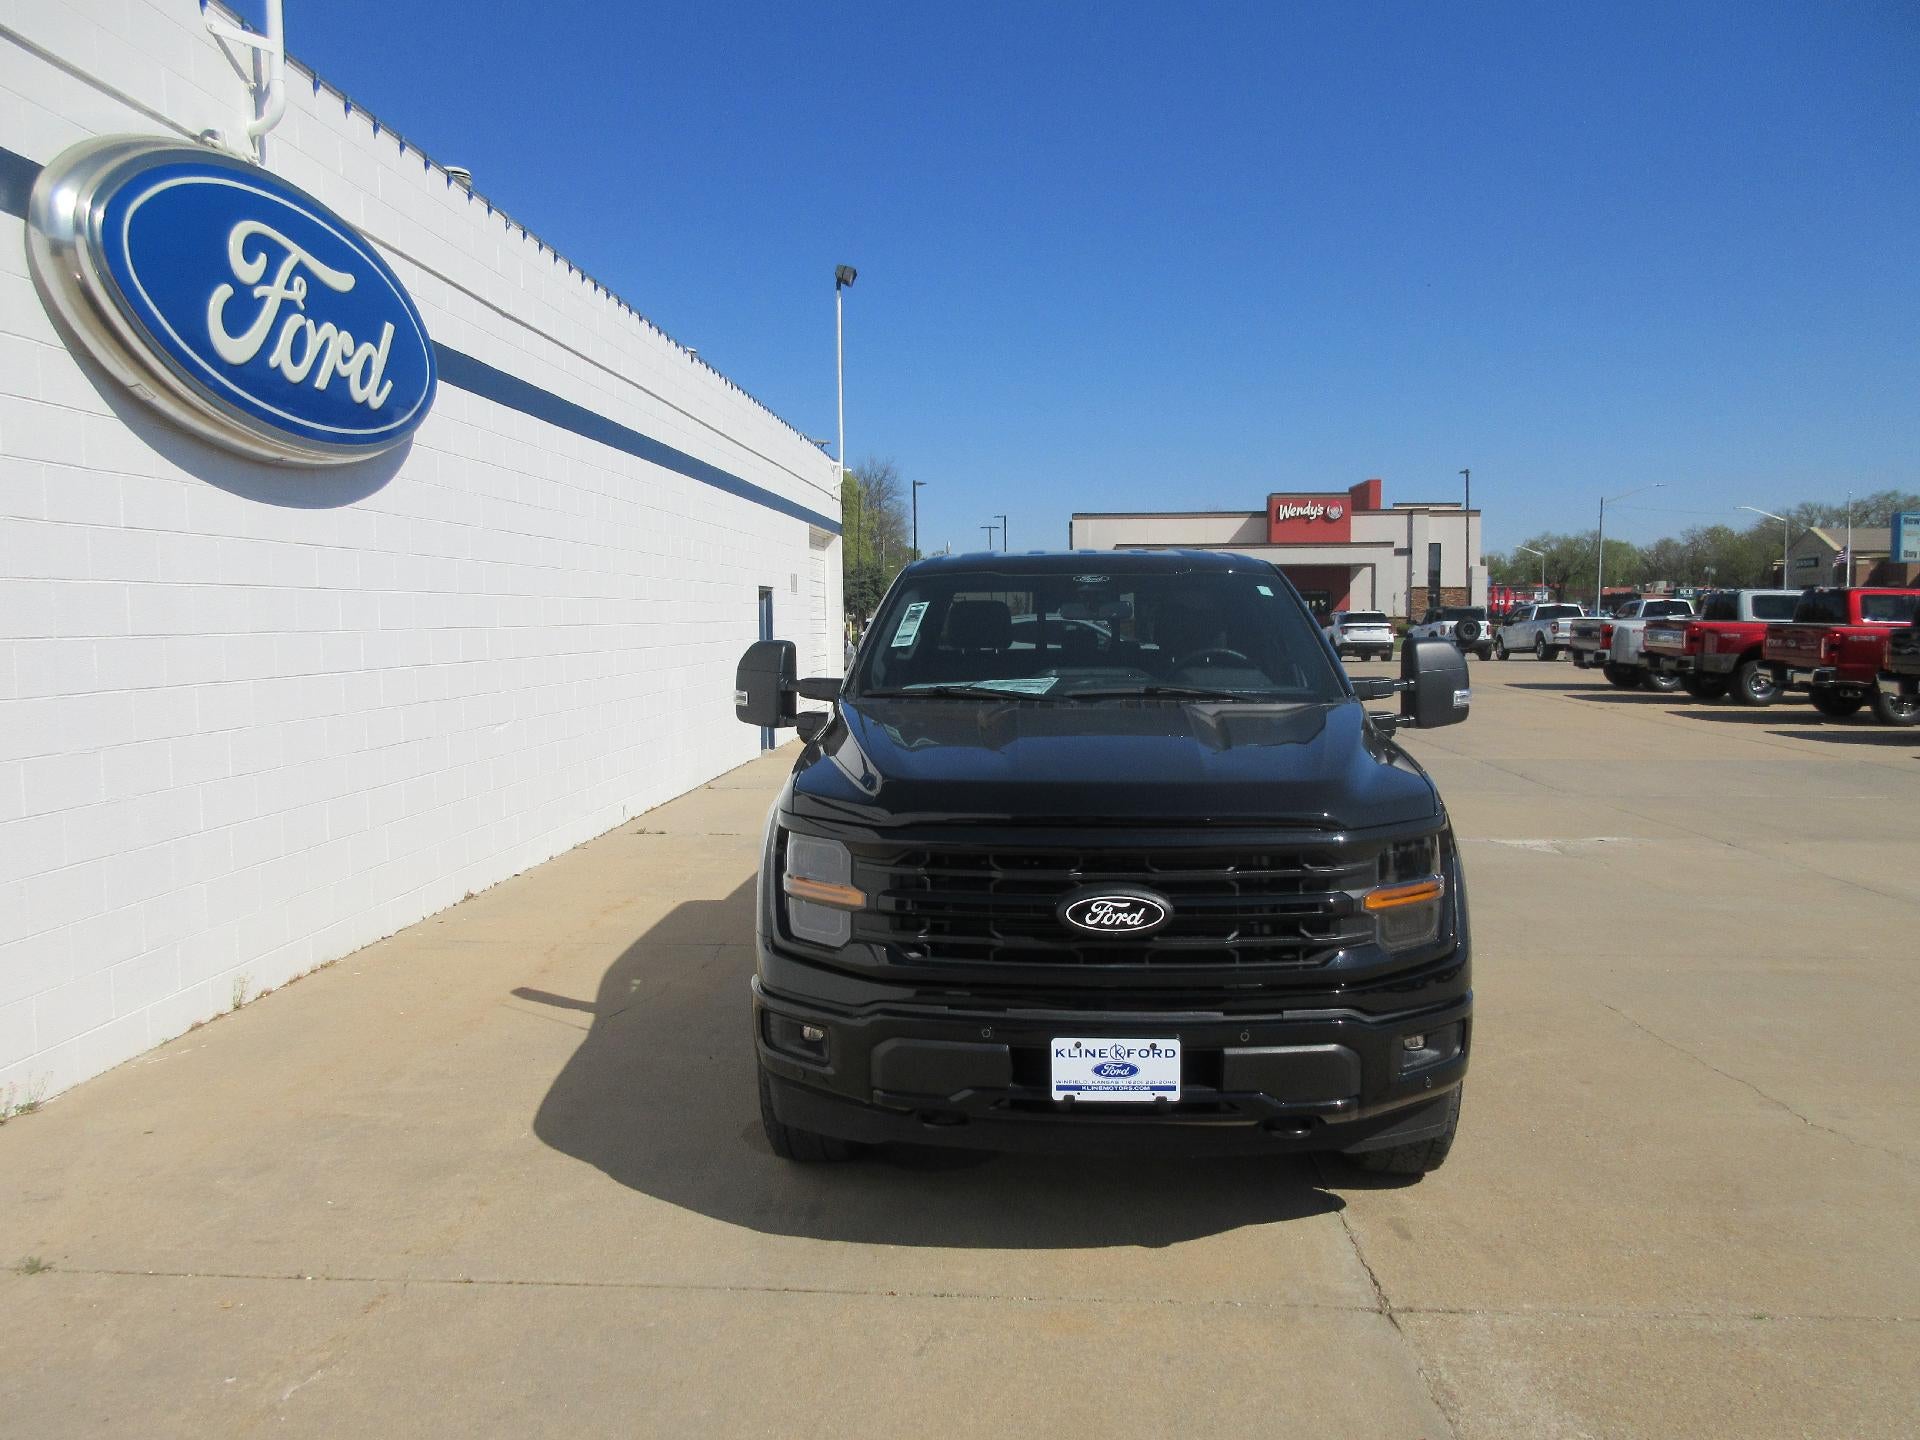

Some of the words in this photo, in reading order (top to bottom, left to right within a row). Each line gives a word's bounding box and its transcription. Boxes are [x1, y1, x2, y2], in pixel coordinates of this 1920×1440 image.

[208, 220, 395, 410] Ford
[1279, 500, 1324, 521] Wendy's
[1085, 900, 1146, 926] Ford
[1055, 1048, 1108, 1059] KLINE
[1127, 1048, 1176, 1059] FORD
[1101, 1063, 1130, 1076] Ford
